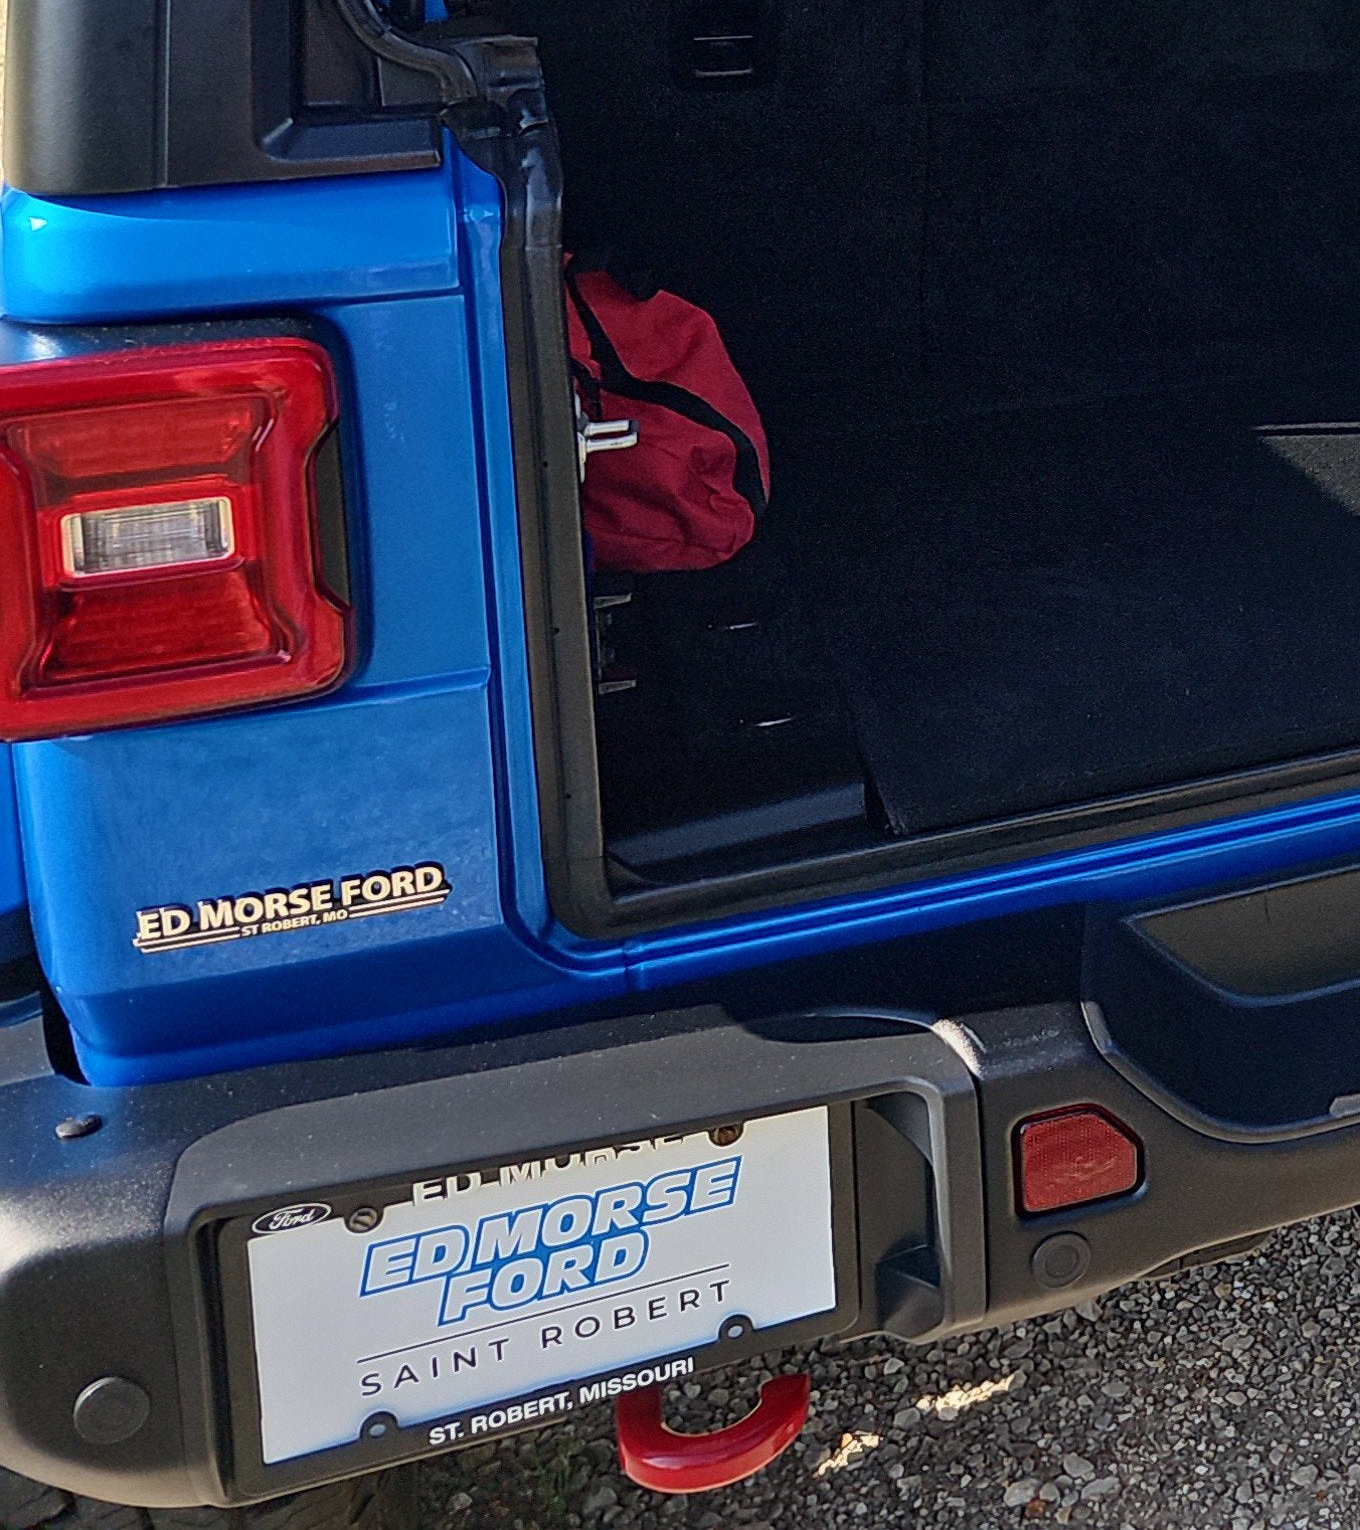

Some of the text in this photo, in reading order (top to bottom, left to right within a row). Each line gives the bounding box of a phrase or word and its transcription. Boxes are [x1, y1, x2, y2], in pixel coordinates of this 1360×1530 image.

[138, 866, 443, 939] ED MORSE FORD
[241, 909, 348, 937] ST ROBERT, MO
[269, 1208, 315, 1230] Ford
[360, 1155, 743, 1298] ED MORSE
[413, 1171, 482, 1207] ED
[438, 1227, 649, 1327] FORD
[361, 1280, 730, 1396] SAINT ROBERT
[429, 1357, 696, 1445] ST. ROBERT, MISSOURI
